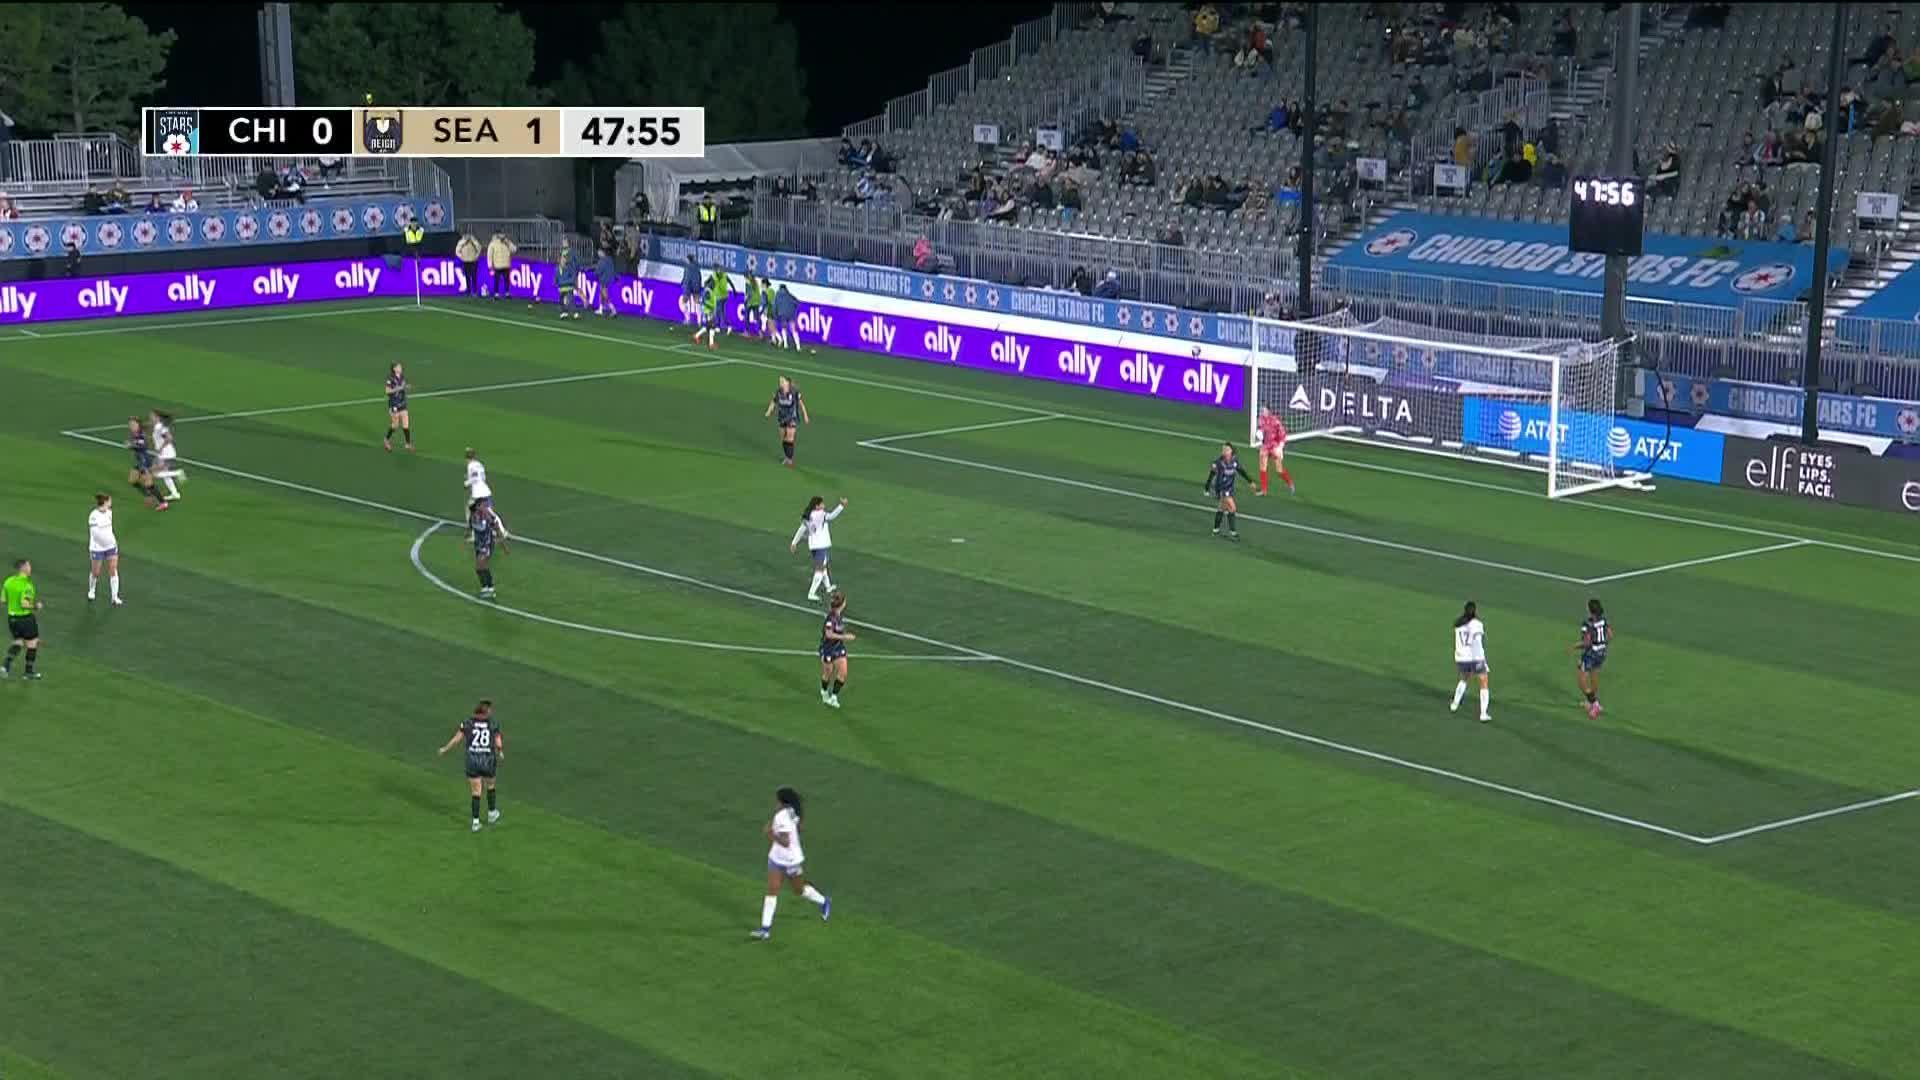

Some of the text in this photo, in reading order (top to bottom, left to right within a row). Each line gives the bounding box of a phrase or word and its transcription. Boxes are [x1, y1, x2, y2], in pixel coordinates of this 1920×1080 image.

[1574, 180, 1635, 207] 47:56
[421, 260, 467, 292] ally
[1408, 234, 1569, 272] CHICAGO
[1669, 258, 1740, 288] FC
[168, 273, 216, 305] ally
[253, 268, 299, 299] ally
[335, 262, 381, 293] ally
[510, 264, 542, 296] ally
[827, 264, 867, 288] CHICAGO
[900, 275, 911, 295] FC
[0, 286, 36, 319] lly
[78, 280, 129, 312] ally
[621, 280, 654, 314] ally
[1011, 291, 1105, 322] CHICAGO STARS FC
[797, 307, 832, 341] ally
[859, 316, 896, 352] ally
[1217, 319, 1268, 347] CHICAO
[924, 325, 962, 361] ally
[990, 336, 1030, 372] ally
[1058, 345, 1102, 383] ally
[1120, 353, 1164, 393] ally
[1183, 363, 1230, 404] ally
[1320, 387, 1413, 423] DELTA
[1856, 404, 1876, 428] FC
[1525, 420, 1569, 443] ATT
[1634, 437, 1683, 461] AT&T
[1800, 452, 1836, 469] EYES.
[1799, 482, 1834, 498] FACE.
[1800, 467, 1831, 483] LIPS.
[471, 729, 490, 747] 28
